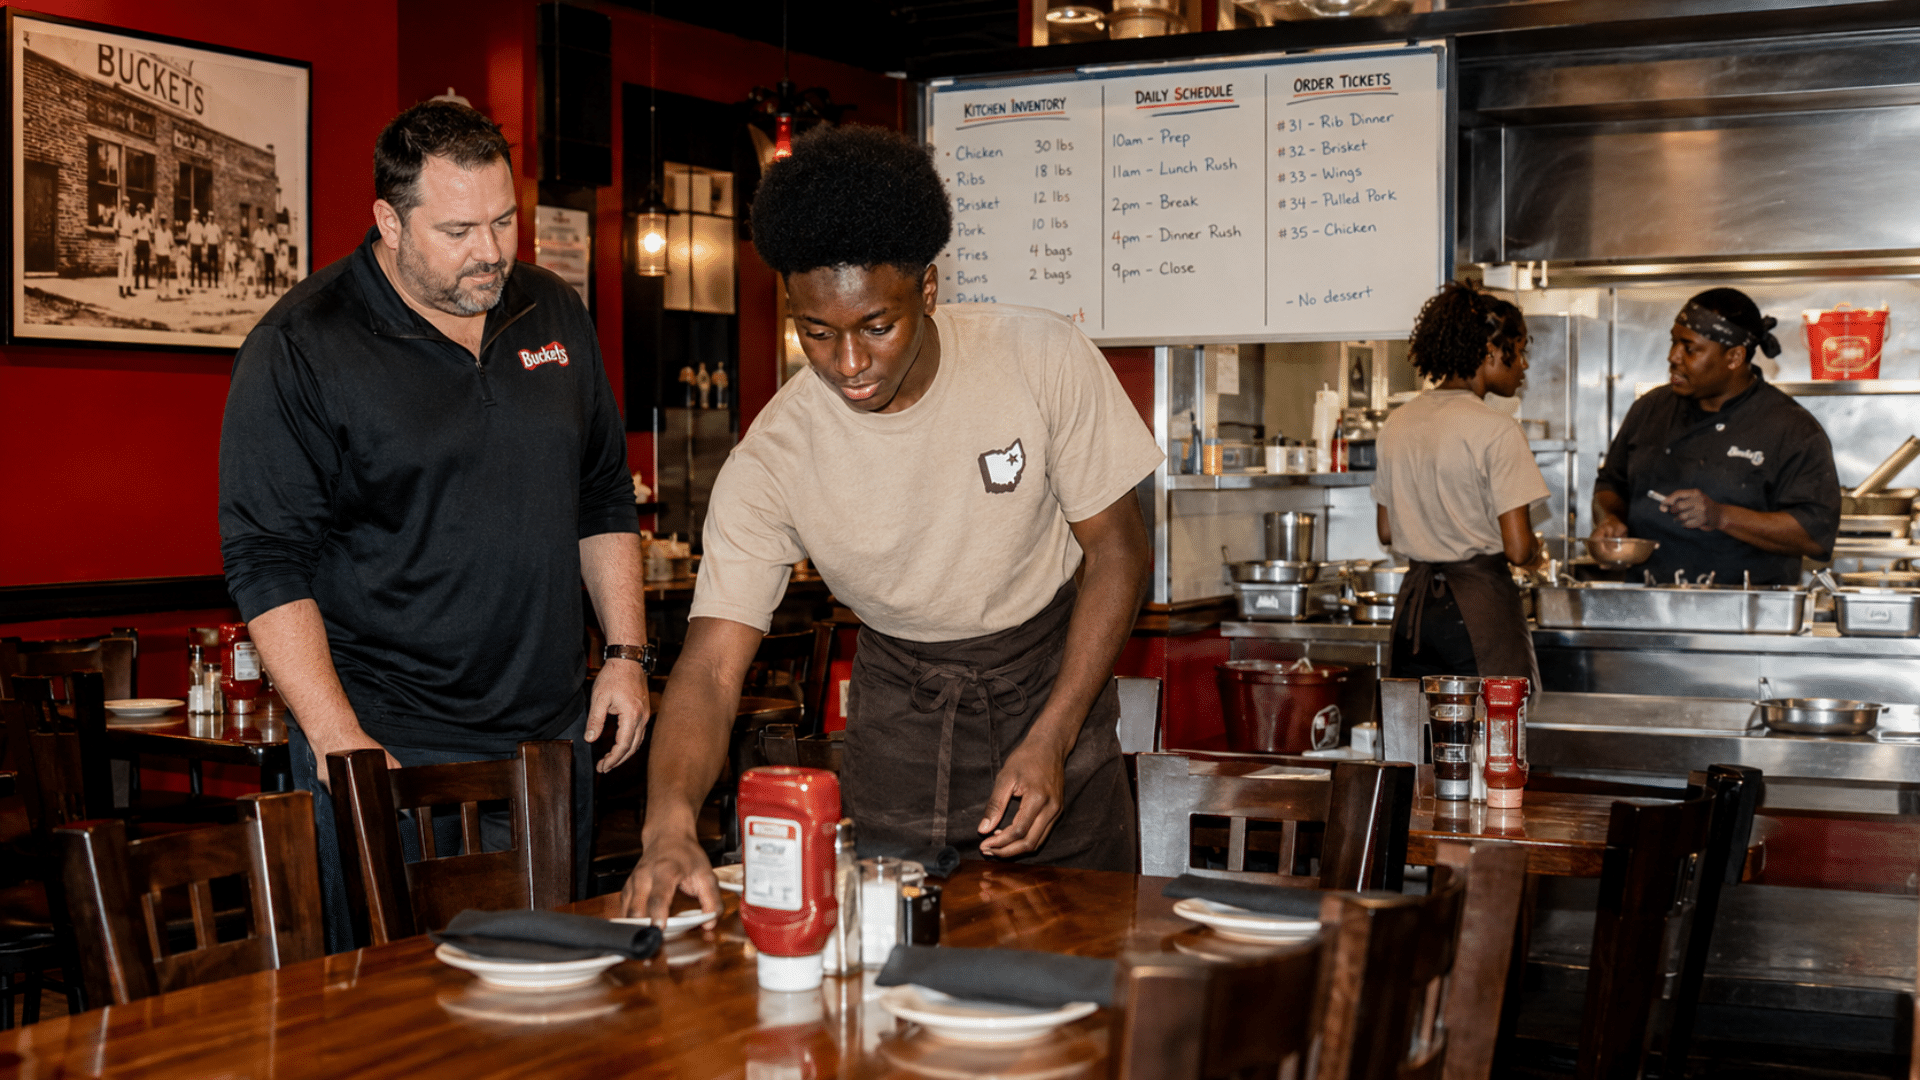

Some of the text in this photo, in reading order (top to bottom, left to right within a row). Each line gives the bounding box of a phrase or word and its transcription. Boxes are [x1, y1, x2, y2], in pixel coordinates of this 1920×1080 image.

[98, 43, 204, 116] BUCKETS
[1293, 72, 1391, 93] ORDER TICKETS
[1135, 84, 1233, 104] DAILY SCHEDULE
[964, 97, 1067, 118] KITCHEN INVENTORY
[1319, 114, 1343, 129] Rib
[1350, 112, 1394, 126] Dinner
[1112, 133, 1142, 147] 10am
[1160, 128, 1190, 147] Prep
[1321, 139, 1368, 155] Brisket
[955, 138, 1074, 161] Chicken 30 lbs
[956, 163, 1072, 187] Ribs 18 lbs
[1112, 165, 1141, 178] 11am
[1159, 160, 1198, 176] Lunch
[1204, 157, 1238, 171] Rush
[1322, 166, 1362, 183] Wings
[956, 190, 1070, 212] Brisket 12 lbs
[1112, 197, 1140, 216] 2pm
[1159, 193, 1199, 210] Break
[1322, 192, 1360, 207] Pulled
[1366, 188, 1397, 203] Pork
[957, 217, 1068, 237] Pork 10 lbs
[1111, 230, 1140, 249] 4pm
[1159, 226, 1201, 242] Dinner
[1208, 224, 1242, 239] Rush
[1324, 222, 1377, 236] Chicken
[957, 244, 1073, 262] Fries 4 bags
[957, 268, 1072, 285] Buns 2 bags
[1111, 262, 1140, 283] 9pm
[1159, 261, 1196, 275] Close
[1298, 292, 1316, 307] No
[1323, 285, 1373, 303] dessert
